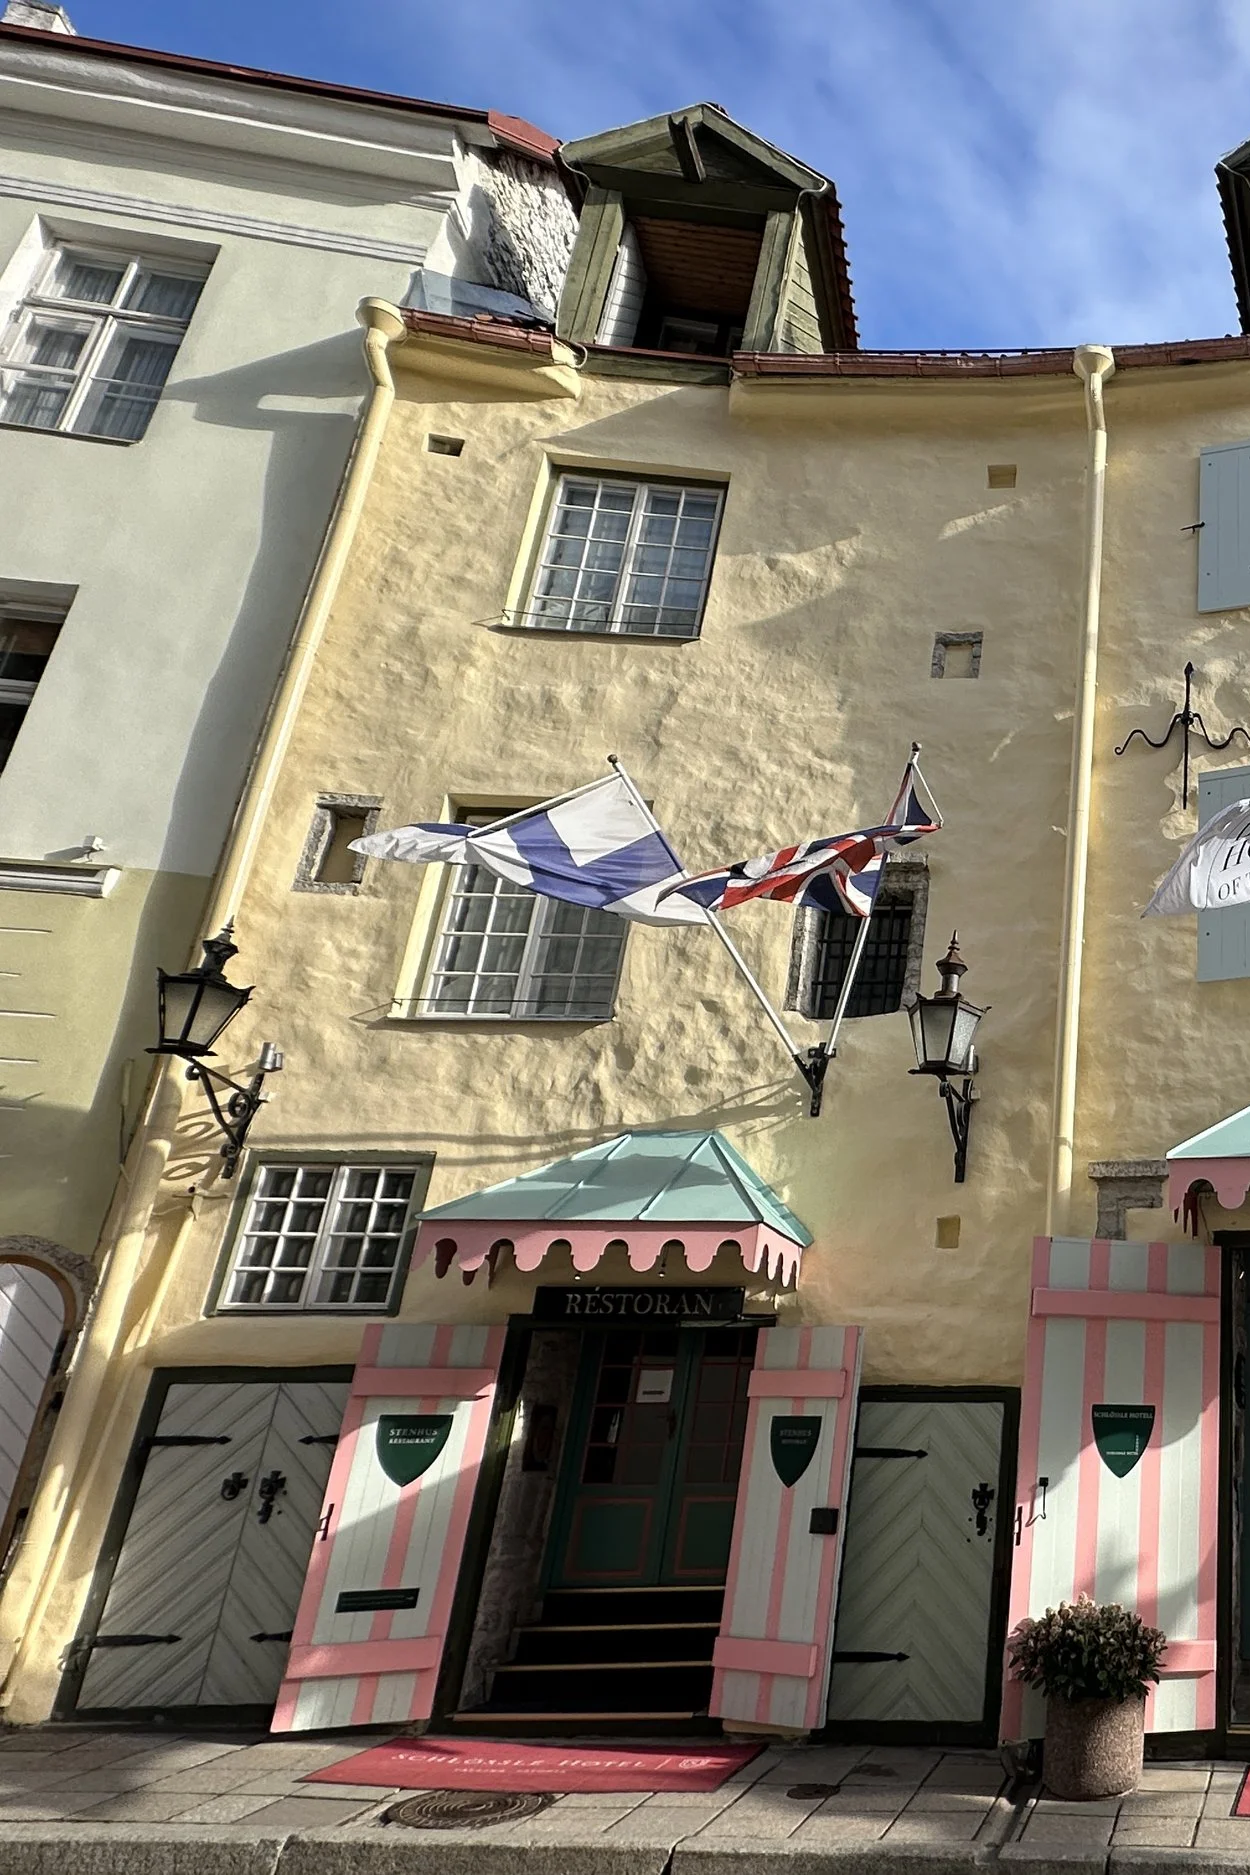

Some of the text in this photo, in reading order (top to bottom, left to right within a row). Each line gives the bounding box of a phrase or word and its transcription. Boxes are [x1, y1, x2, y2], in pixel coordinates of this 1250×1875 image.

[1217, 878, 1242, 901] OF
[564, 1293, 715, 1315] RESTORAN
[389, 1428, 438, 1436] STENHUS
[559, 1758, 647, 1769] HOTEL
